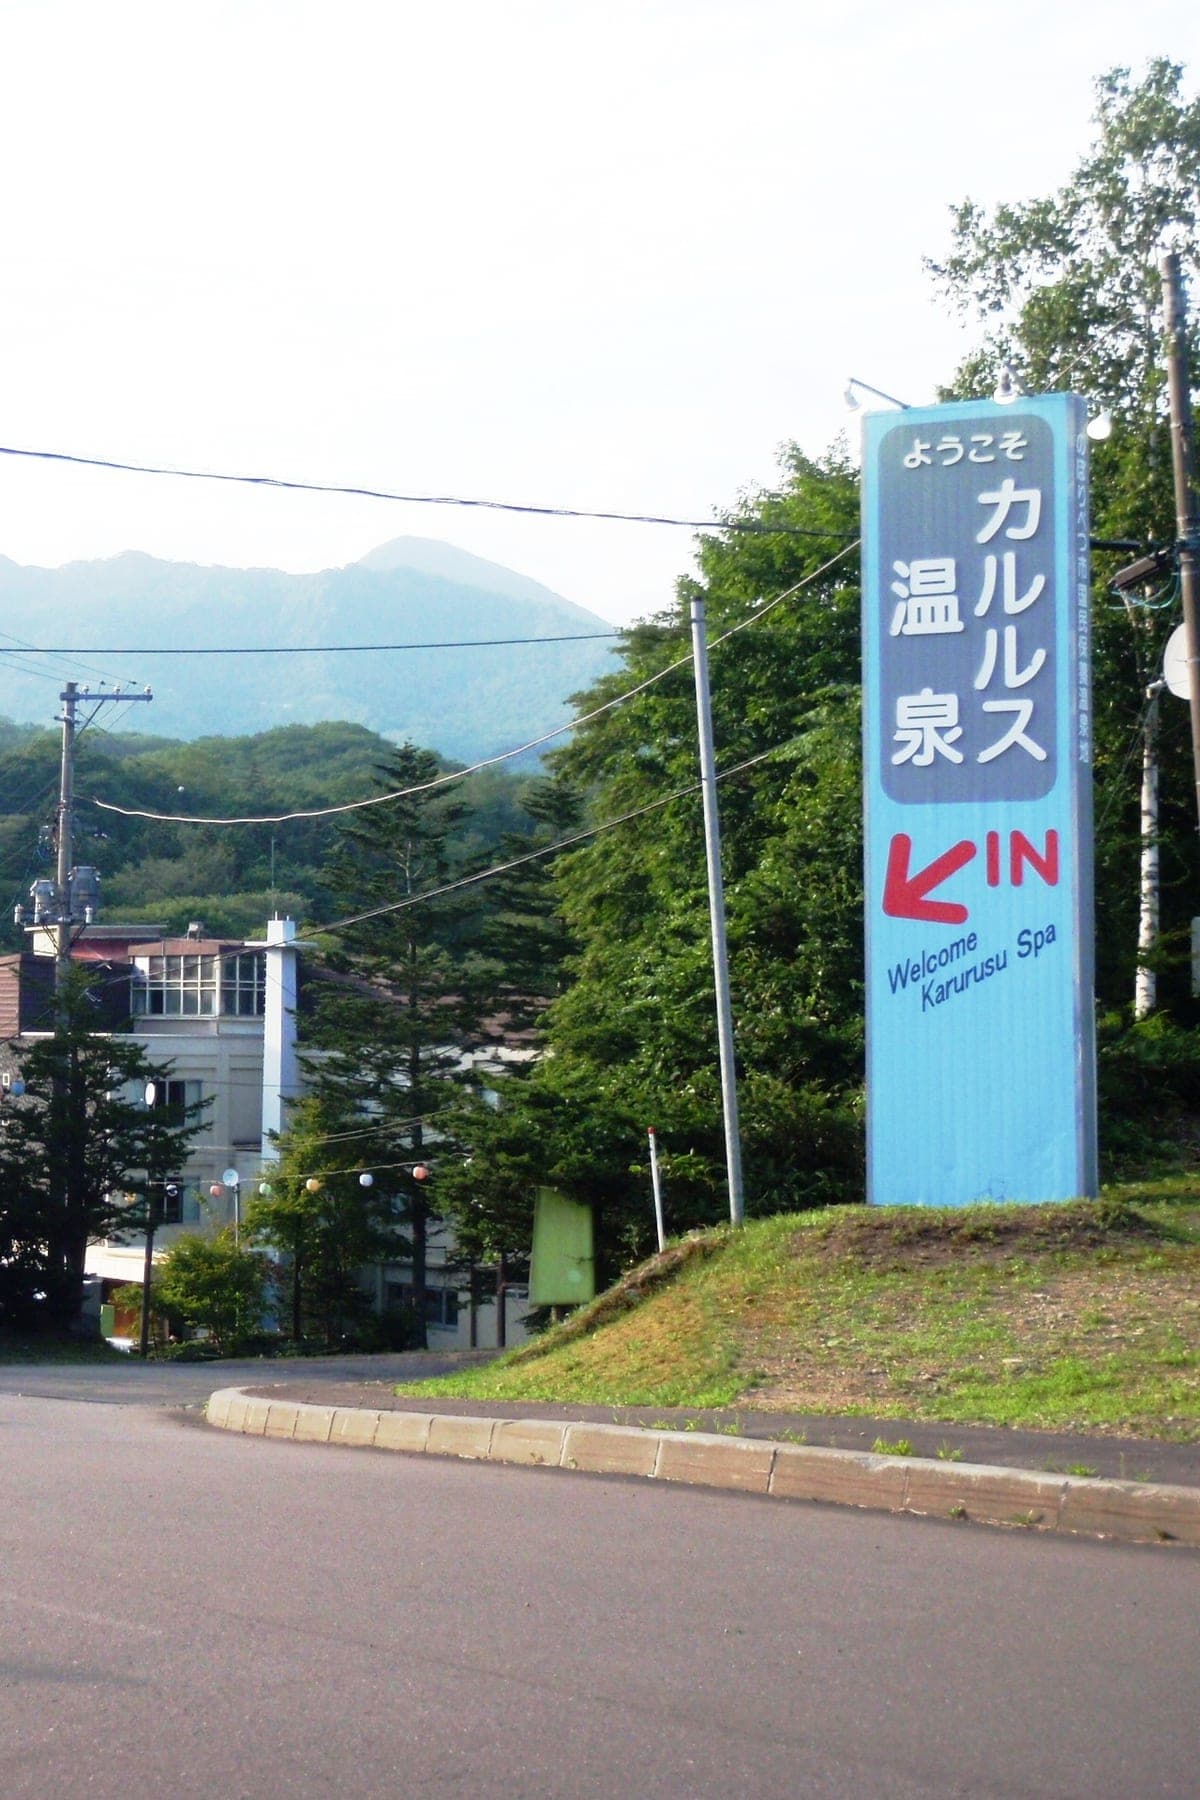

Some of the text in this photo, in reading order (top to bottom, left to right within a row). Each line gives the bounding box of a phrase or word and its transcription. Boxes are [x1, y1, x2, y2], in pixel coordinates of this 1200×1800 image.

[903, 431, 1028, 469] ようこそ
[974, 478, 1047, 764] カルルス
[889, 557, 965, 767] 温泉
[986, 829, 1059, 888] IN
[887, 932, 978, 994] Welcome
[921, 924, 1057, 1012] Karurusu Spa
